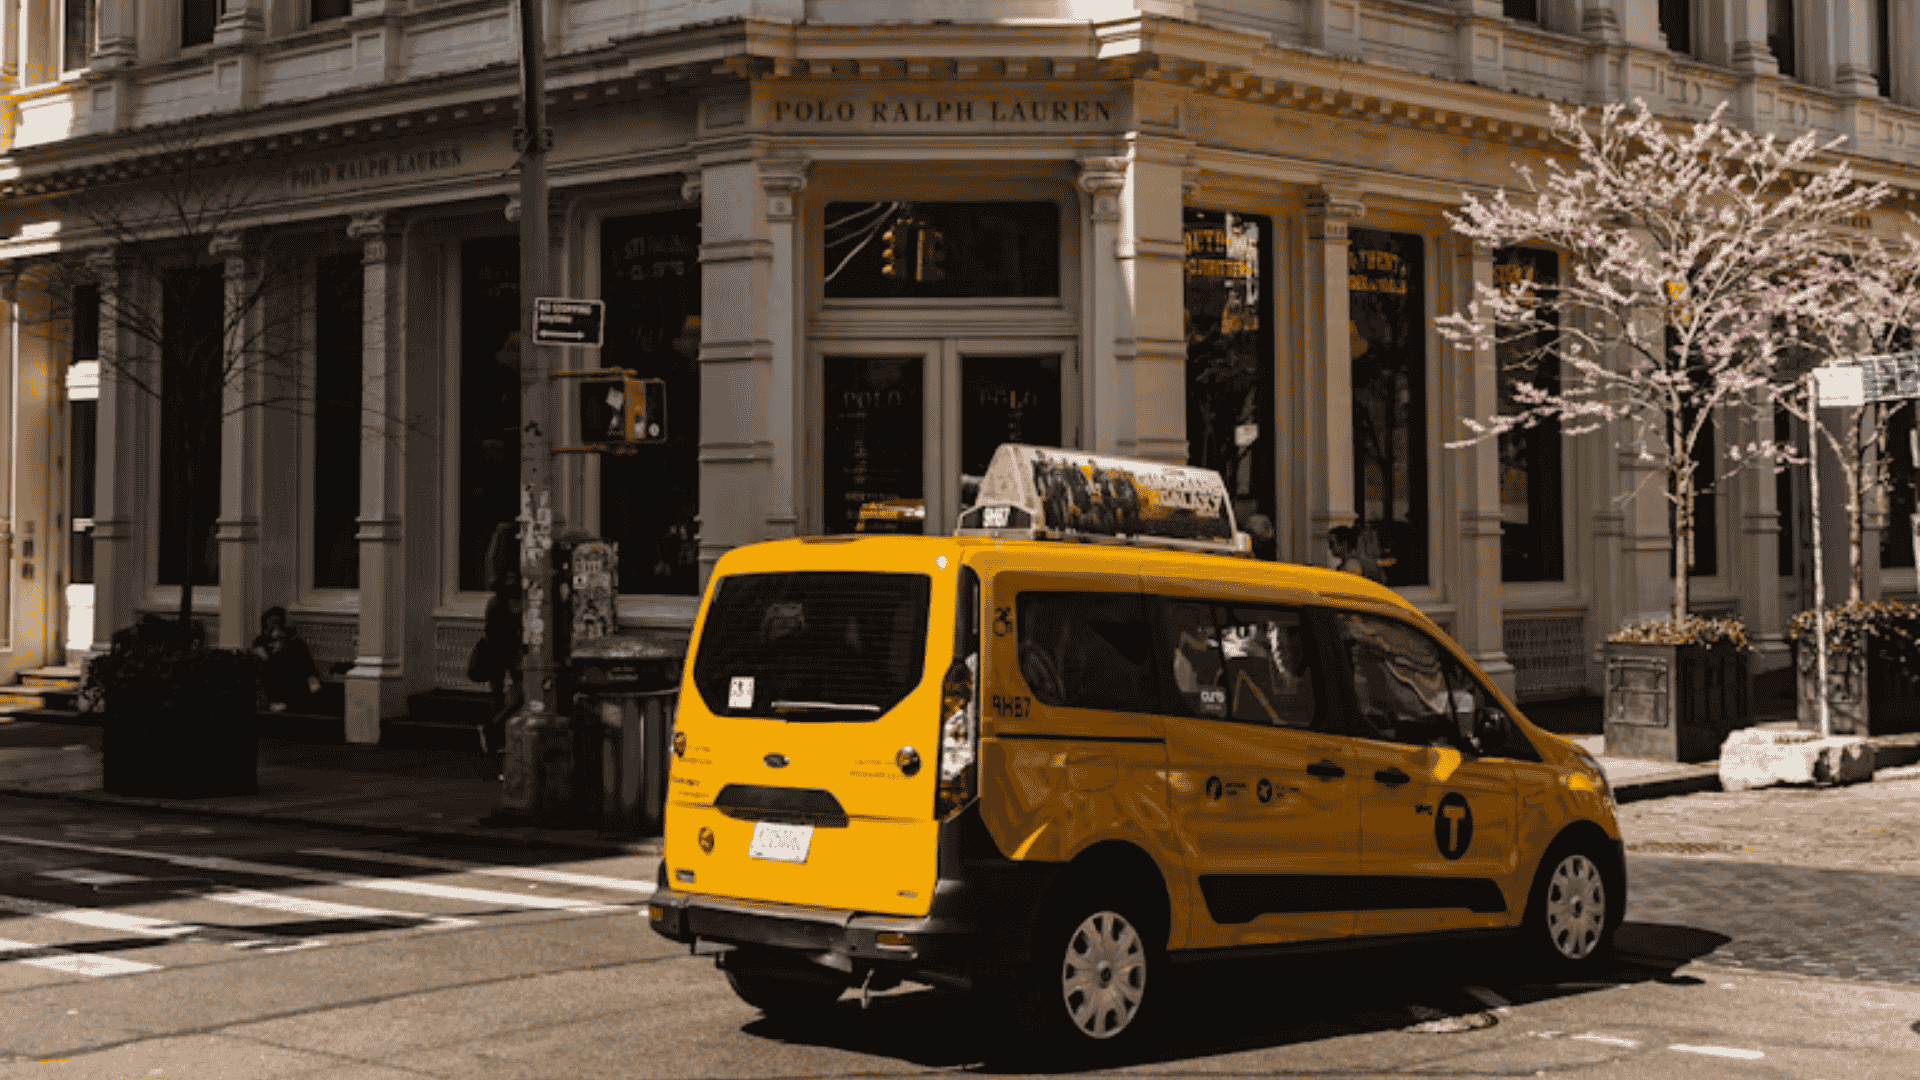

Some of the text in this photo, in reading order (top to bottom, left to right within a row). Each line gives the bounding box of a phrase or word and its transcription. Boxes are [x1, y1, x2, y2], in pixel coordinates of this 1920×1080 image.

[776, 101, 1111, 122] POLO RALPH LAUREN
[290, 148, 462, 187] POLO RALPH LAUREN
